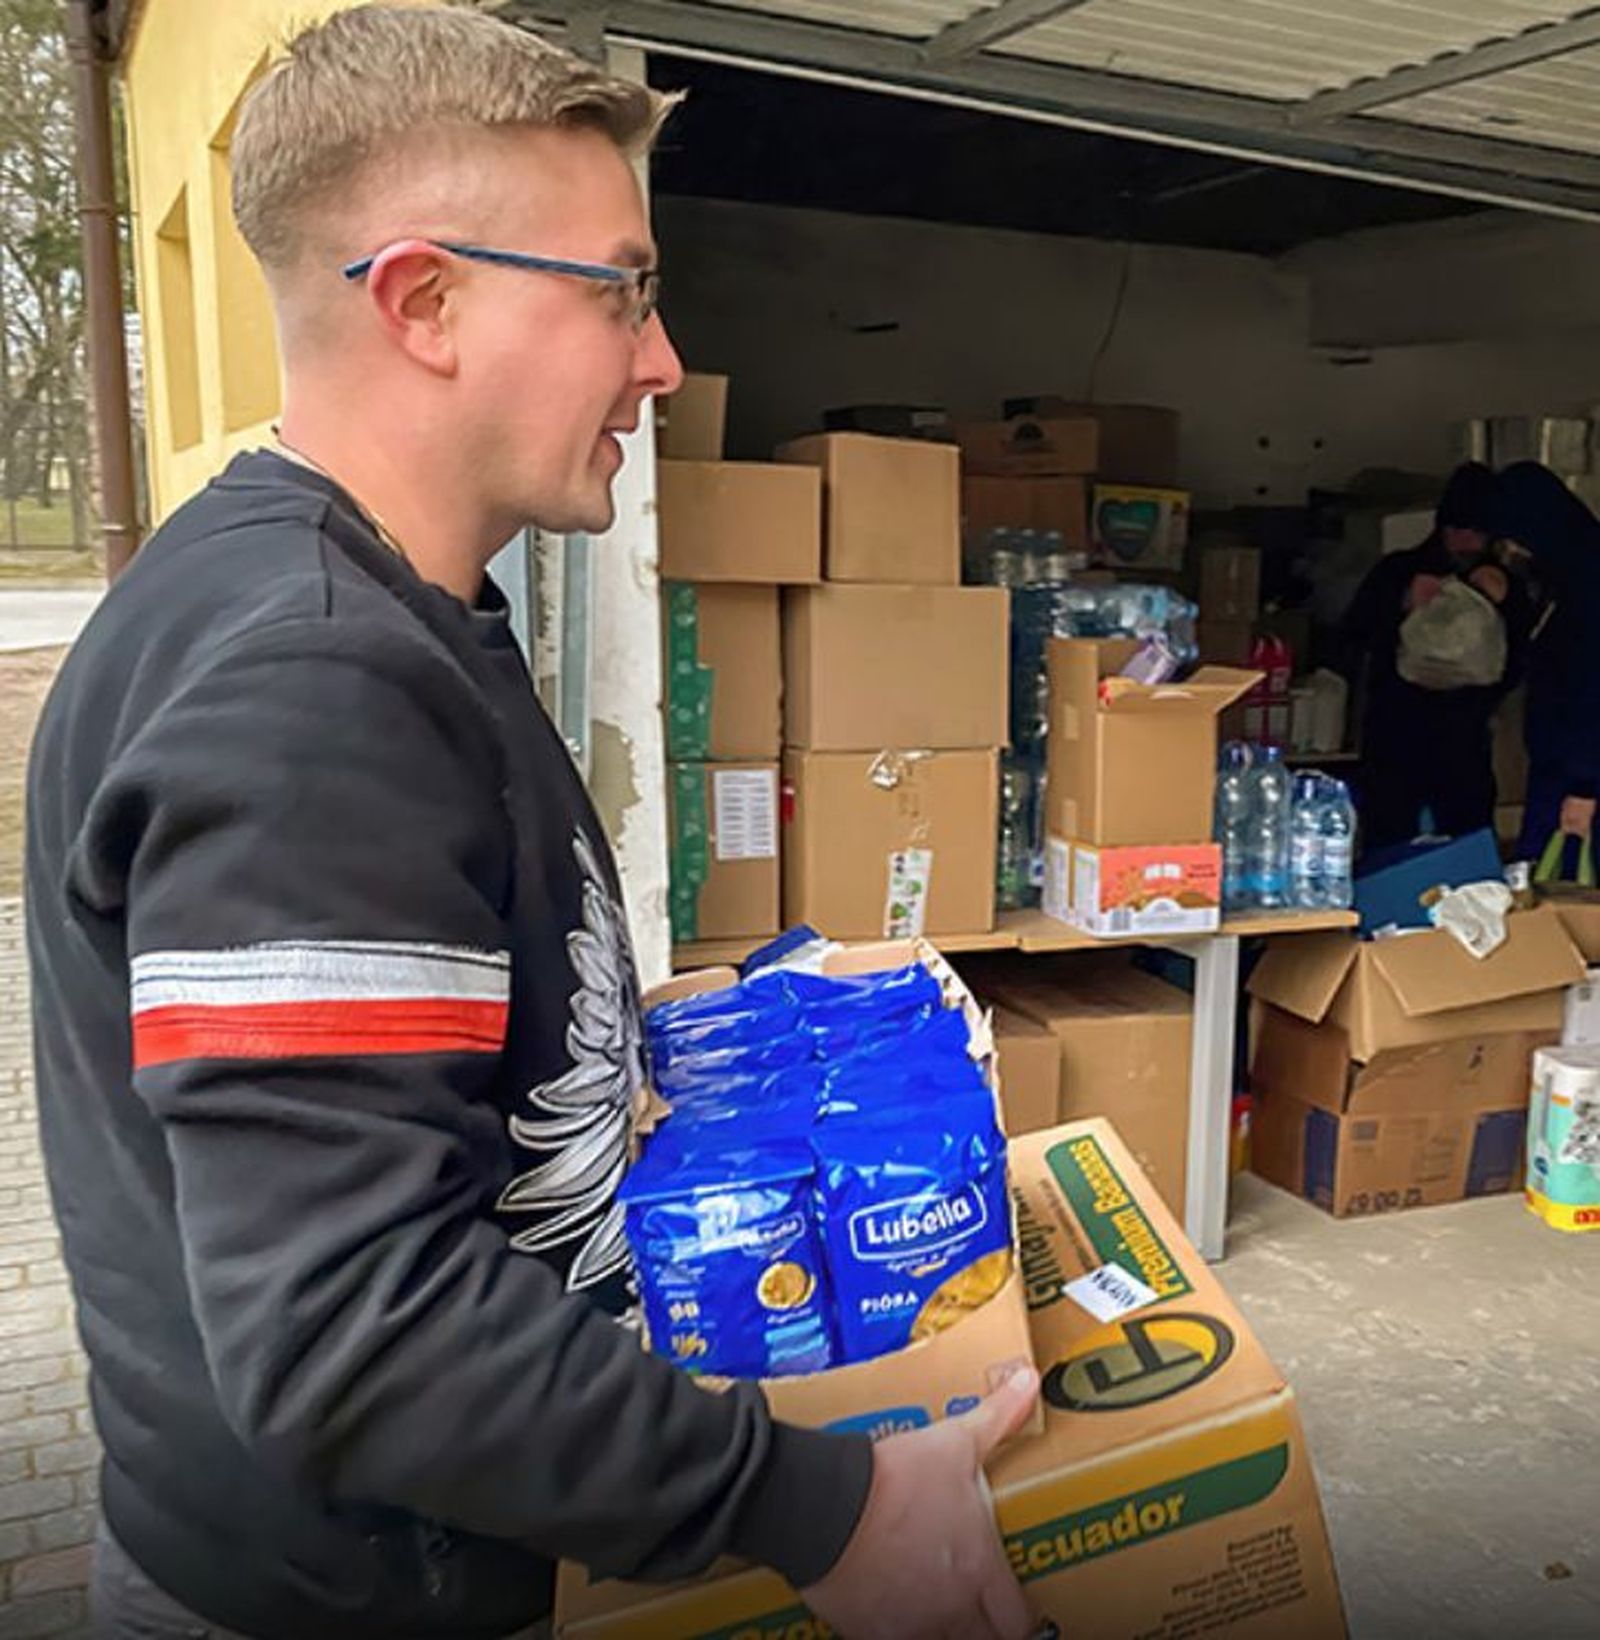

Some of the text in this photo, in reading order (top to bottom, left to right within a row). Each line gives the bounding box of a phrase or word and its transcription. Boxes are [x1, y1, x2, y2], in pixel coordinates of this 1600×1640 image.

[866, 1197, 972, 1245] Lubella
[1112, 1206, 1187, 1296] Premium
[1005, 1493, 1186, 1577] Ecuador
